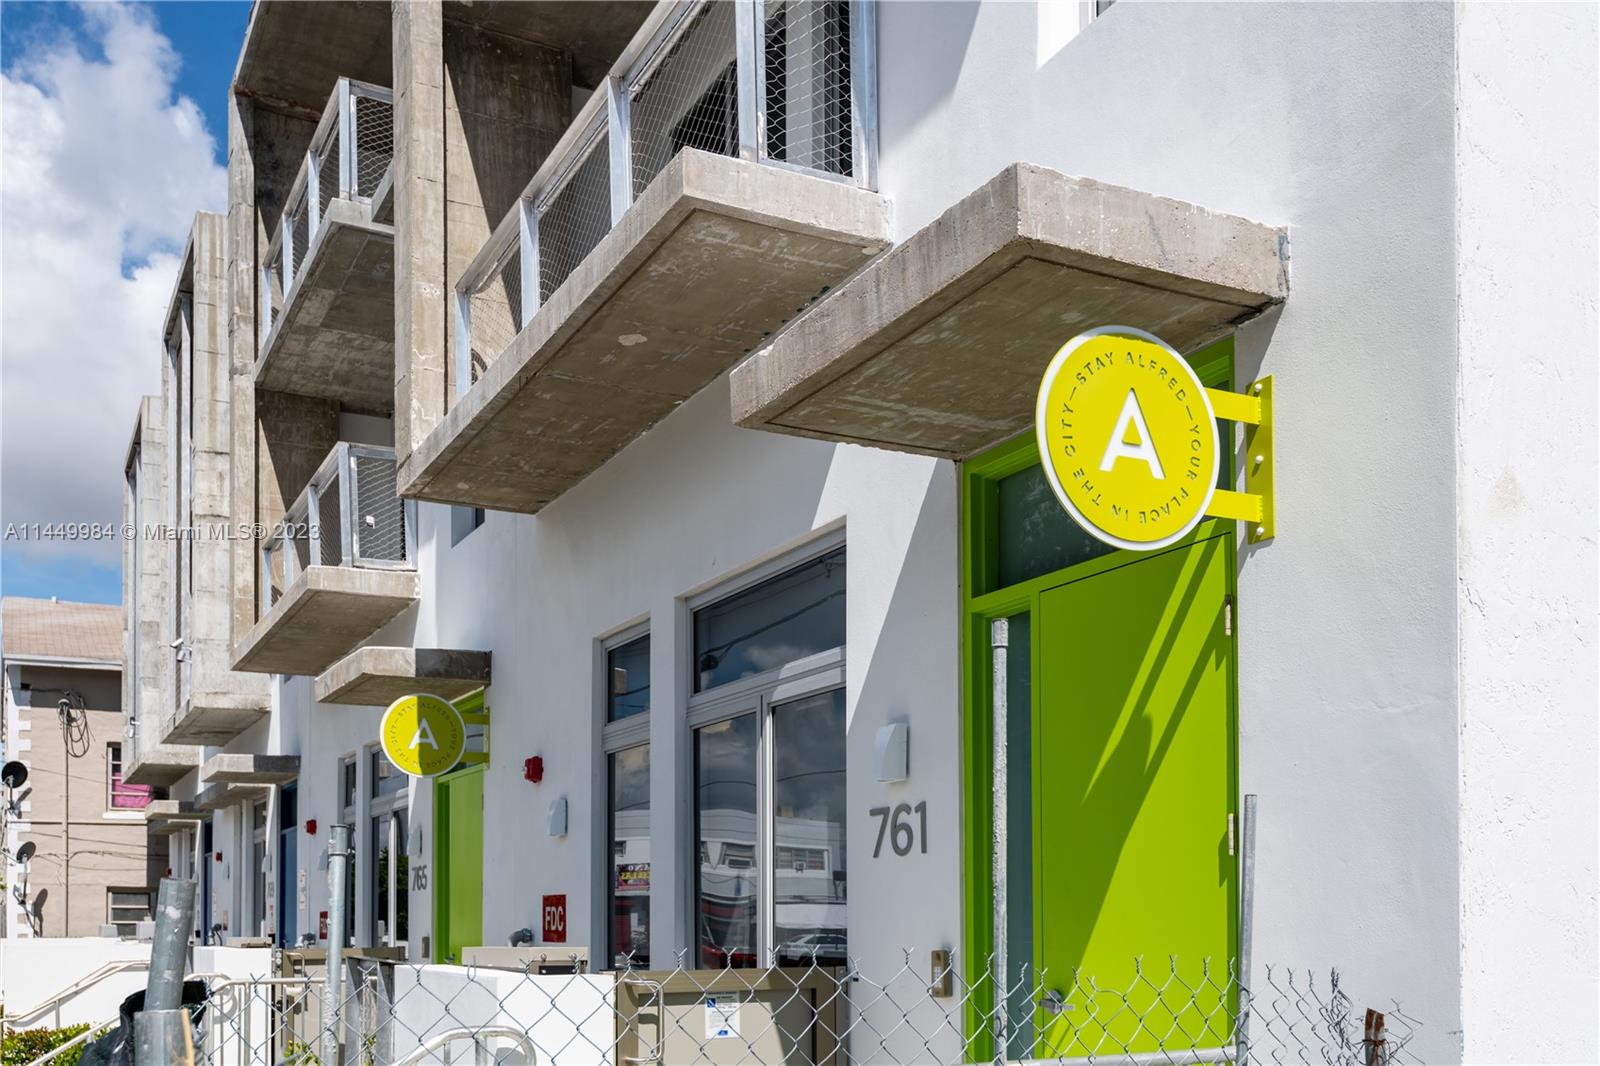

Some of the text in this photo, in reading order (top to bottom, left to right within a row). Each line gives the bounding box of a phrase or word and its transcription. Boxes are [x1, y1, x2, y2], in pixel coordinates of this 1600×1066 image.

[1076, 351, 1114, 385] STAY
[1099, 387, 1166, 480] A
[1072, 467, 1102, 506] THE
[1111, 503, 1130, 522] IN
[1138, 486, 1190, 525] PLACE
[408, 717, 439, 750] A
[869, 800, 928, 858] 761
[412, 864, 428, 891] 765
[545, 905, 564, 931] FDC
